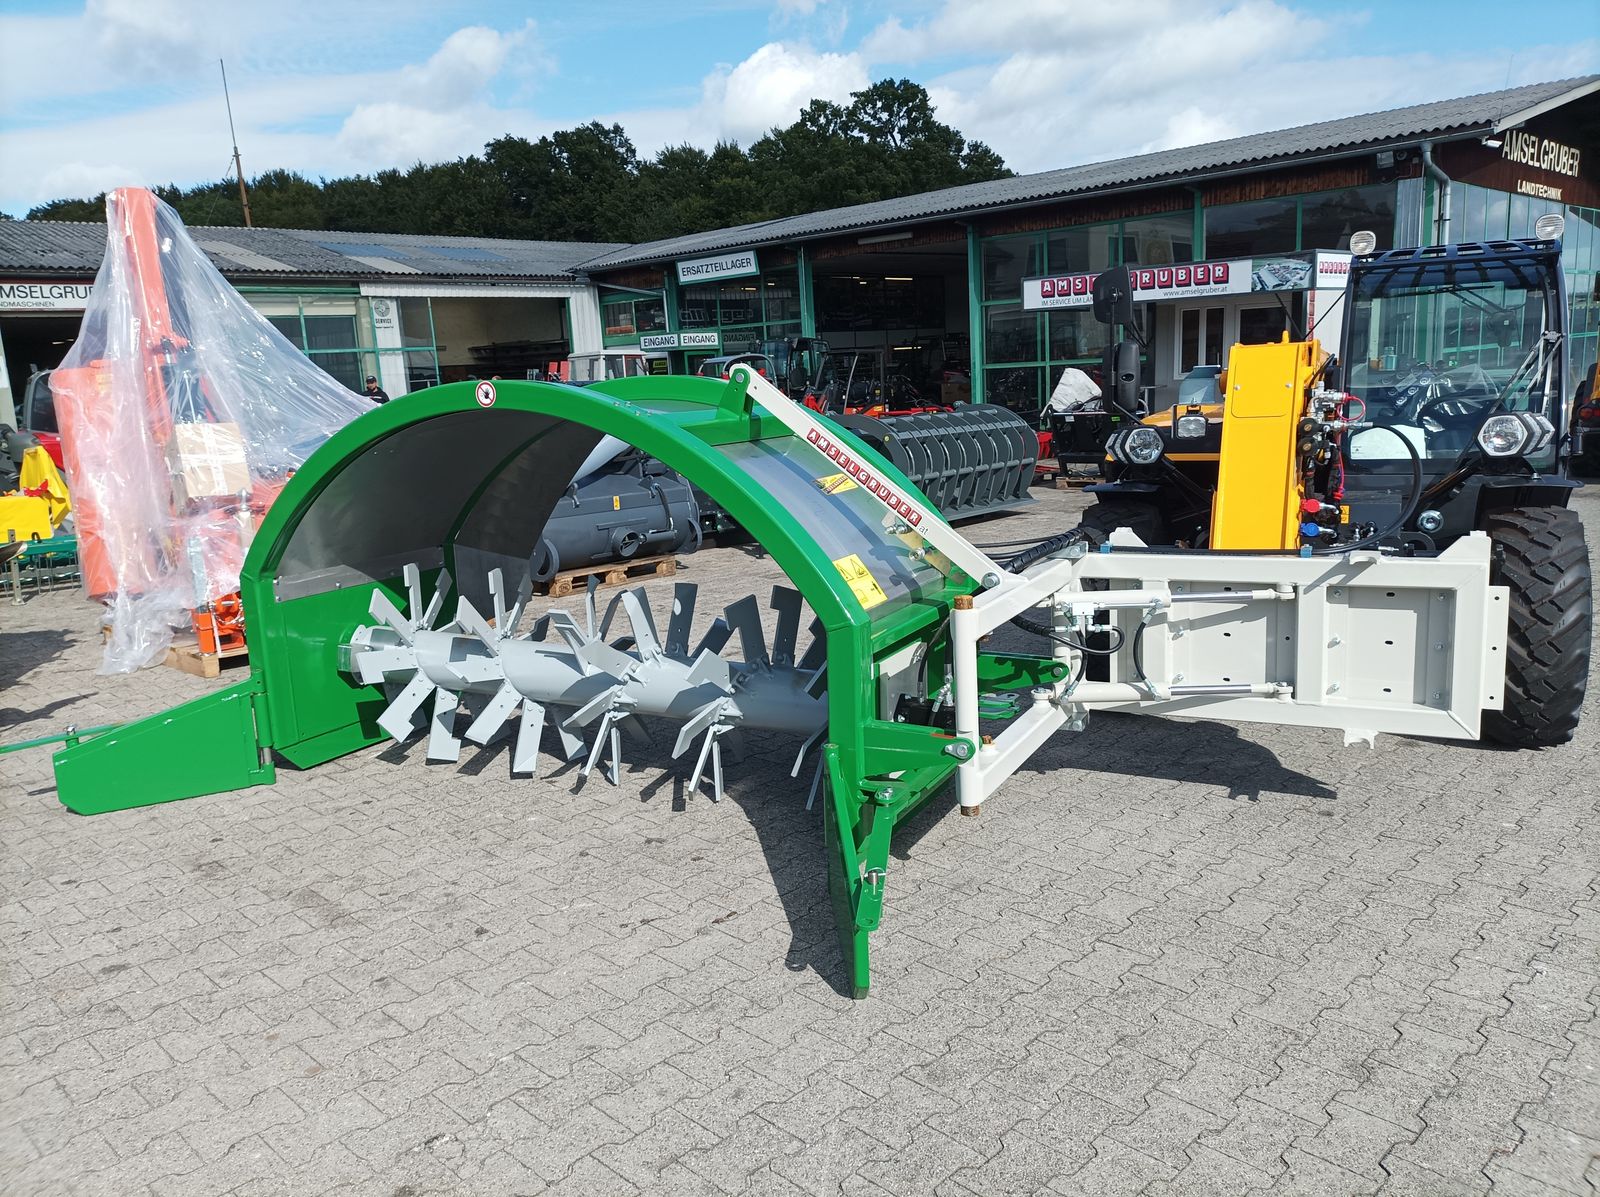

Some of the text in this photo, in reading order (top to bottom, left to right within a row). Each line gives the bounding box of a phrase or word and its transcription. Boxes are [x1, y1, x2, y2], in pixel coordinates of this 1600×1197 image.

[1502, 130, 1580, 177] AMSELGRUBER
[1517, 180, 1562, 200] LANDTECHNIK
[681, 257, 752, 276] ERSATZTEILLAGER
[1041, 264, 1228, 298] AMSRUBER
[1163, 286, 1228, 297] www.amselgruber.at
[1049, 298, 1071, 306] SERVICE
[643, 336, 675, 347] EINGANG
[683, 334, 716, 344] EINGANG
